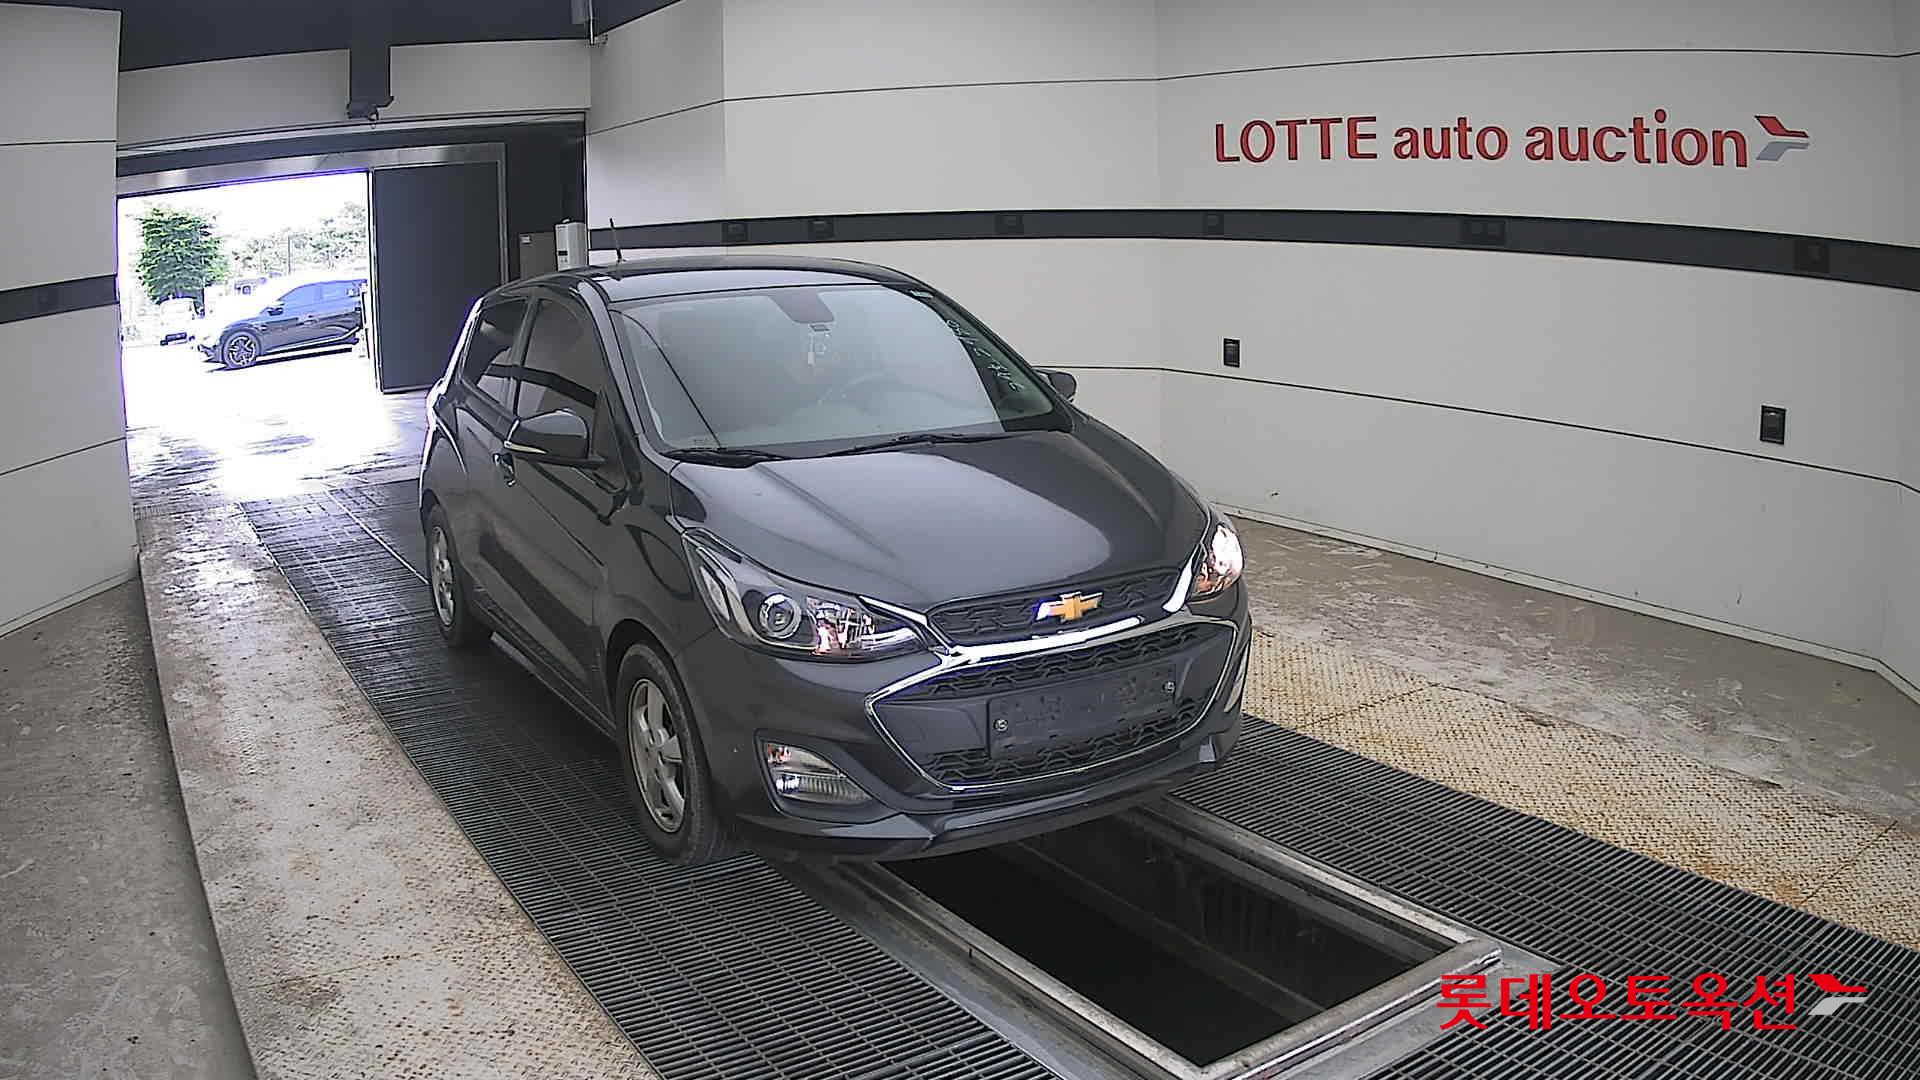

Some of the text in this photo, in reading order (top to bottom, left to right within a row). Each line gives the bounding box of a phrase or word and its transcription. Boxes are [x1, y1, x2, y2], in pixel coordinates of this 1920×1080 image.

[1215, 109, 1748, 168] LOTTE auto auction
